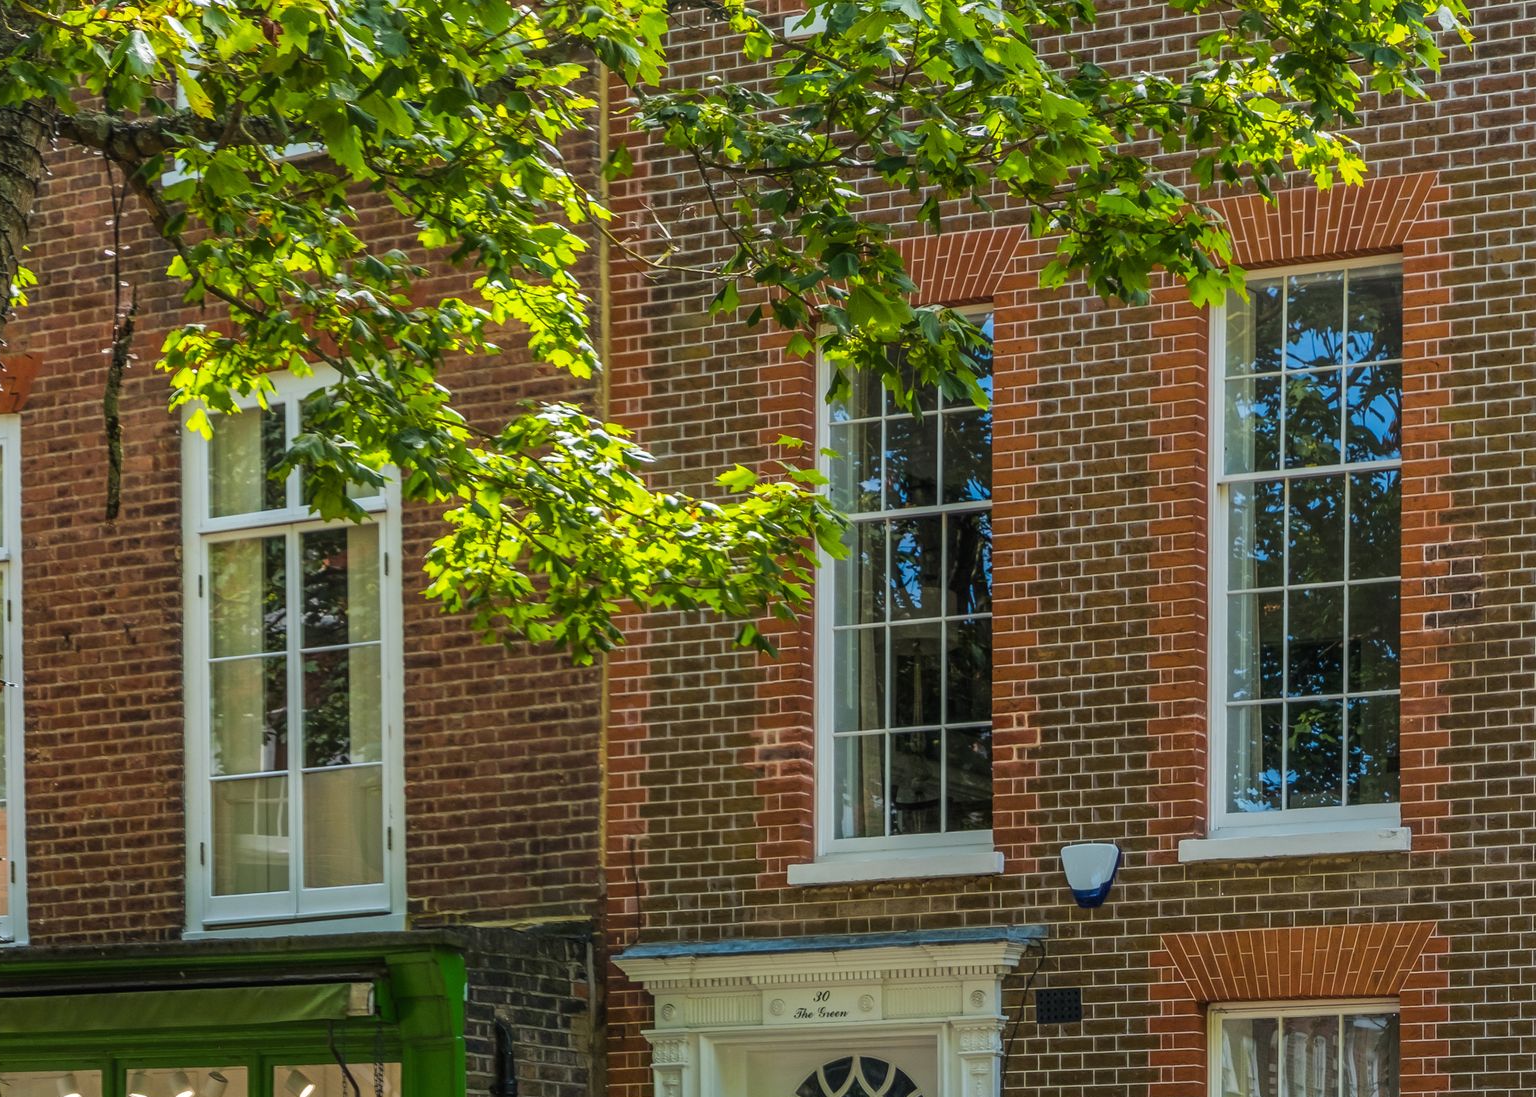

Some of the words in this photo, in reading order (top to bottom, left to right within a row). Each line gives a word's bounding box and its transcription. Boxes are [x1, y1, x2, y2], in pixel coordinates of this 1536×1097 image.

[813, 990, 831, 1003] 30
[793, 1007, 816, 1019] The
[818, 1006, 848, 1019] Green
